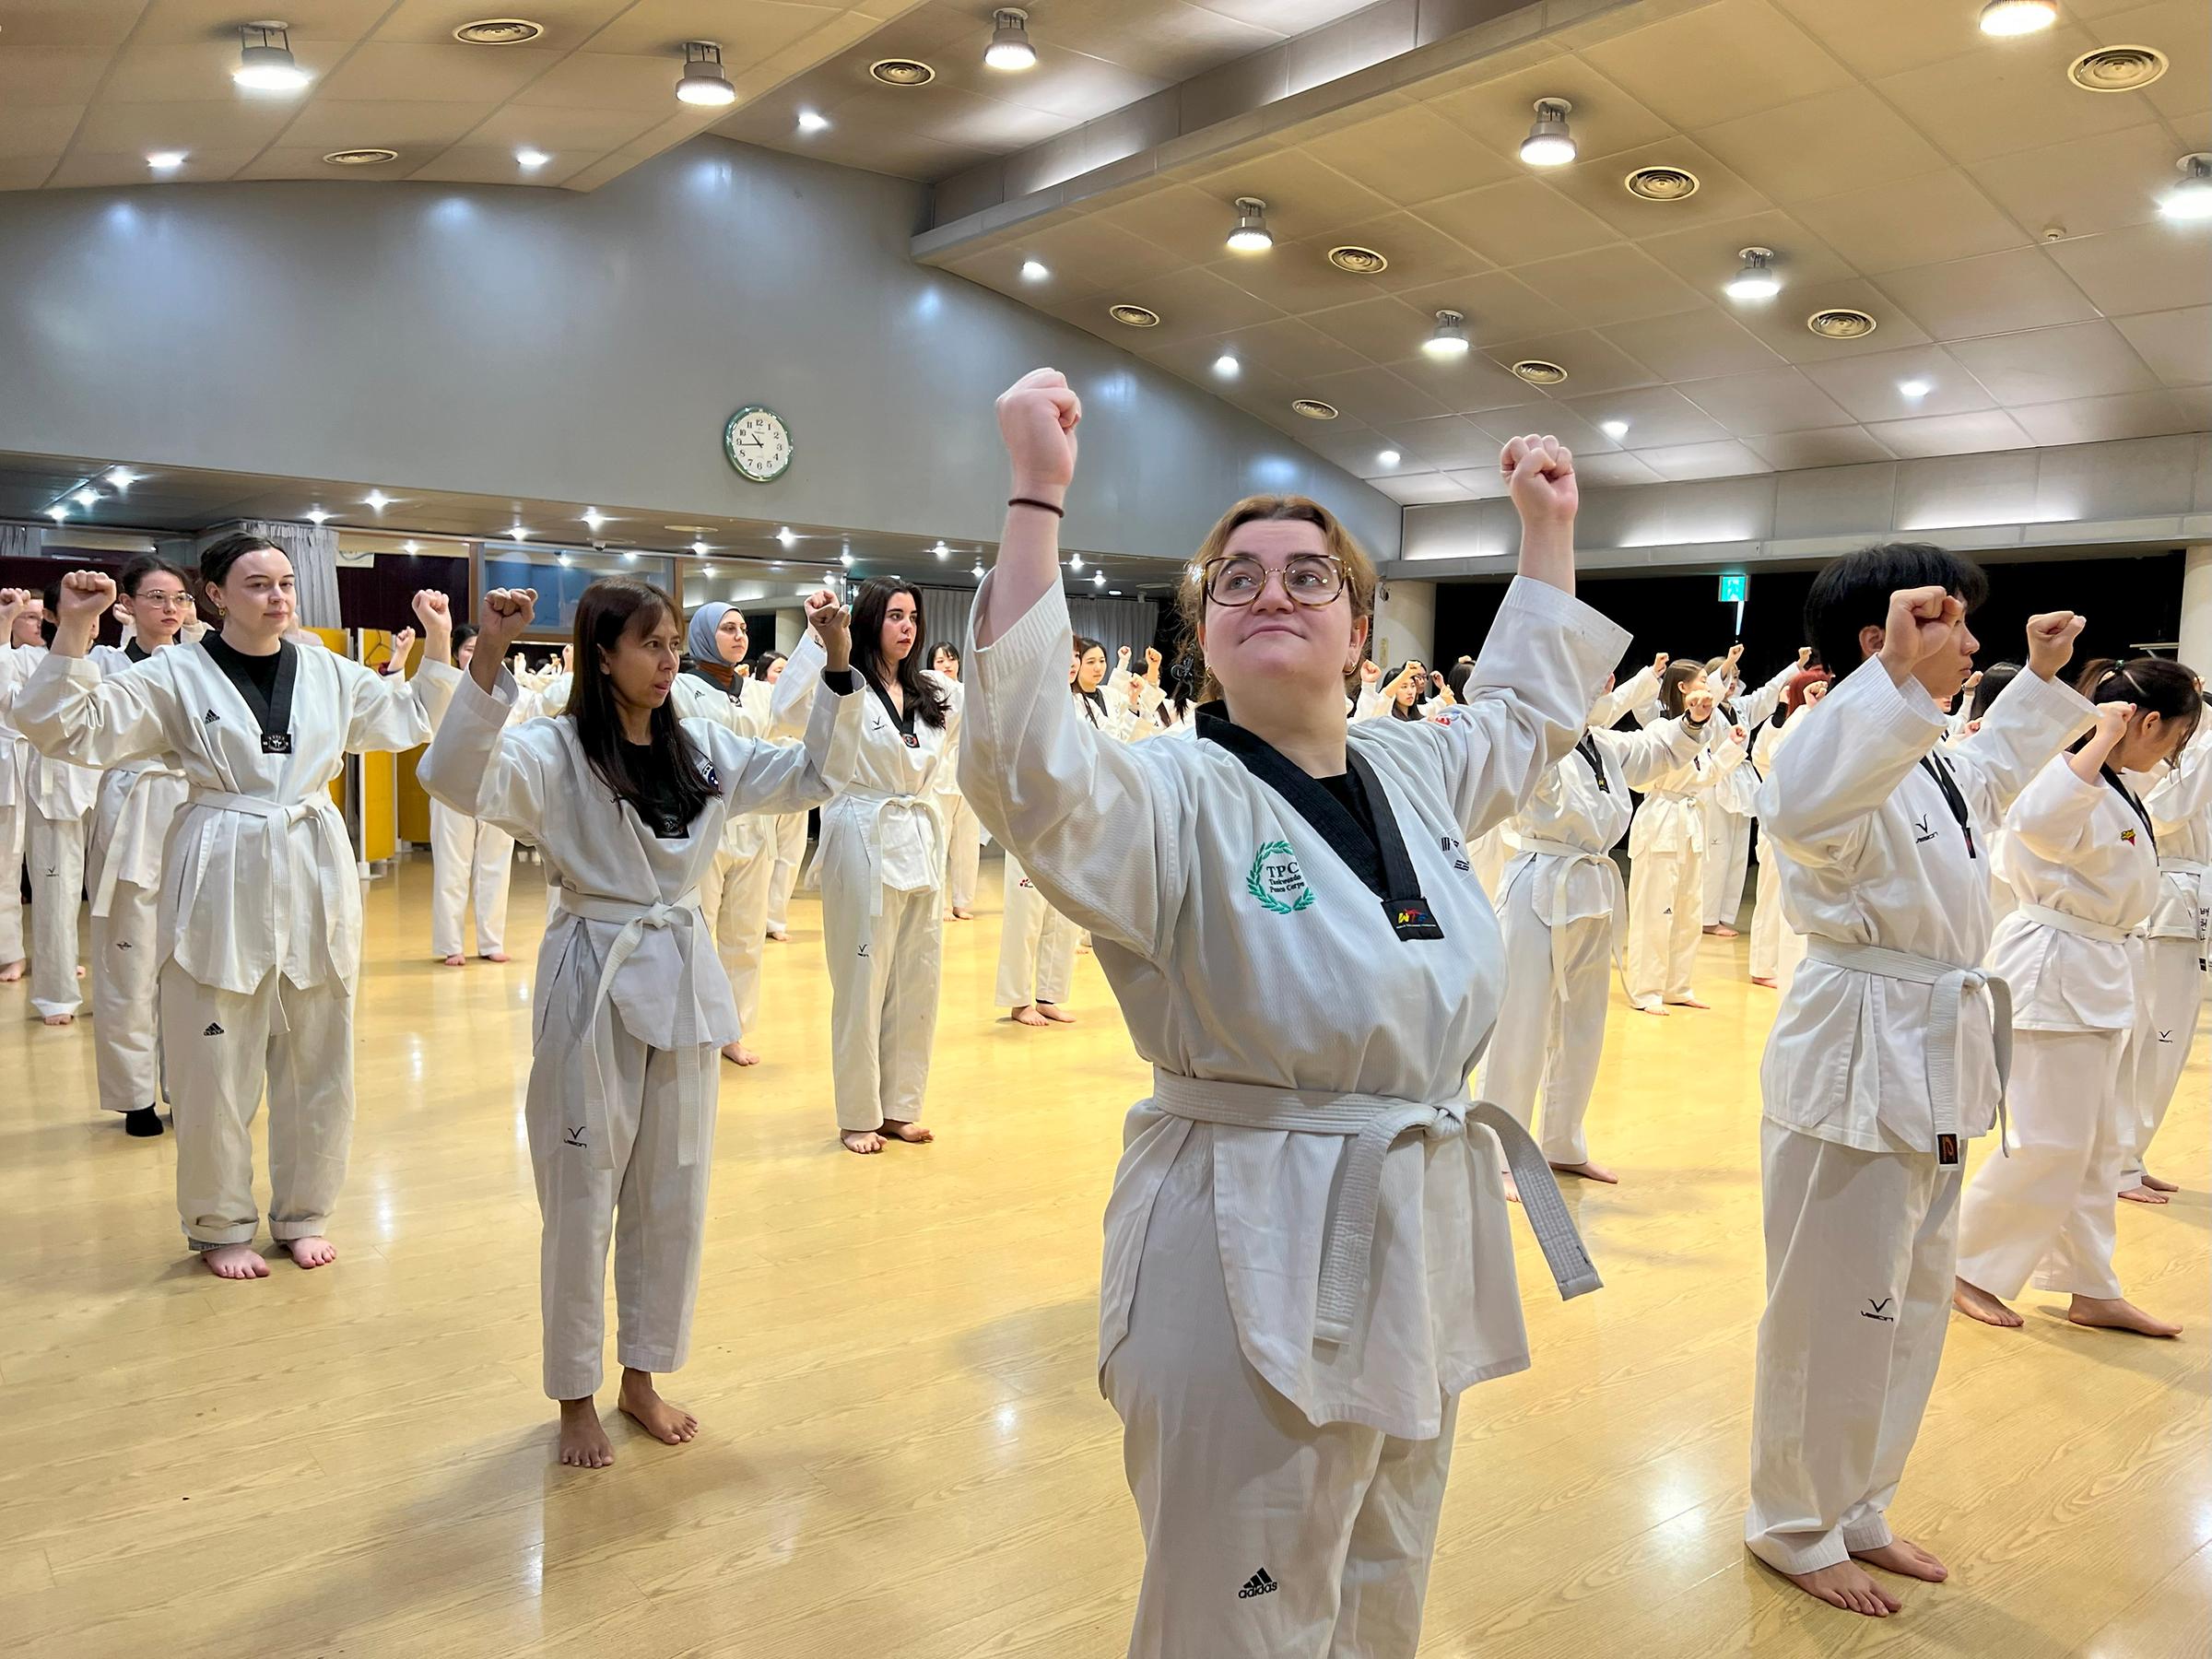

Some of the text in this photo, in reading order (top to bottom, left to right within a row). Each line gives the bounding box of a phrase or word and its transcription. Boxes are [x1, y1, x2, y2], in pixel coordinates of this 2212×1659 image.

[776, 443, 782, 452] 3
[757, 462, 762, 470] 6
[1266, 862, 1300, 878] TPC
[1286, 882, 1305, 891] Corps
[1238, 1582, 1277, 1599] adidas
